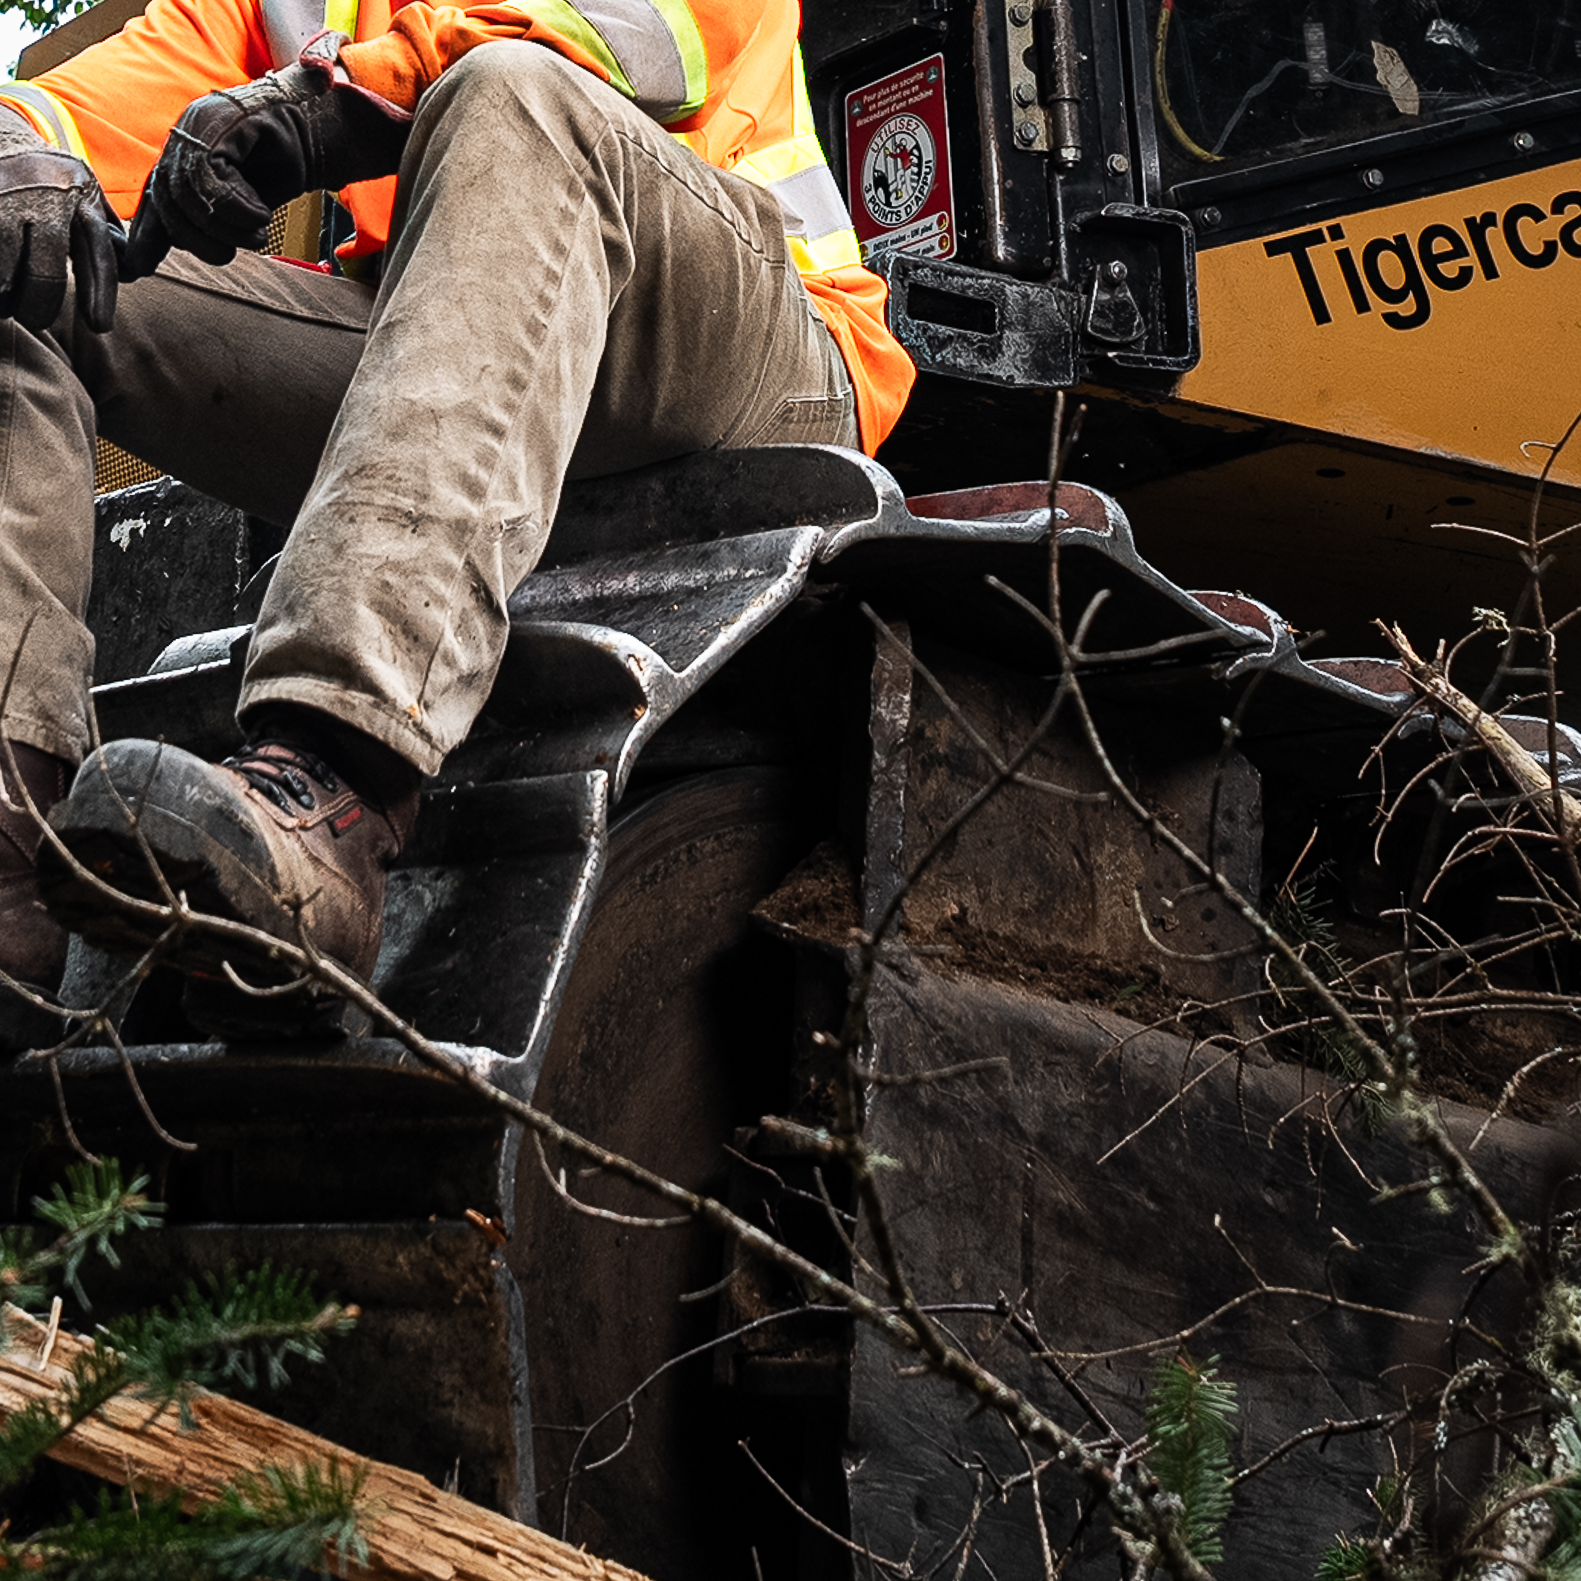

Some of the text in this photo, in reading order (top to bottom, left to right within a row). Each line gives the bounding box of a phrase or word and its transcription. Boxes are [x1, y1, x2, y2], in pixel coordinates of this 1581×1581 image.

[856, 107, 889, 127] descendant
[908, 89, 933, 104] machine
[863, 93, 876, 104] Pour
[878, 87, 889, 99] plus
[891, 82, 899, 92] de
[877, 91, 902, 108] montant
[870, 118, 920, 153] UTILISEZ
[864, 159, 933, 222] 3 POINTS D'APPUI
